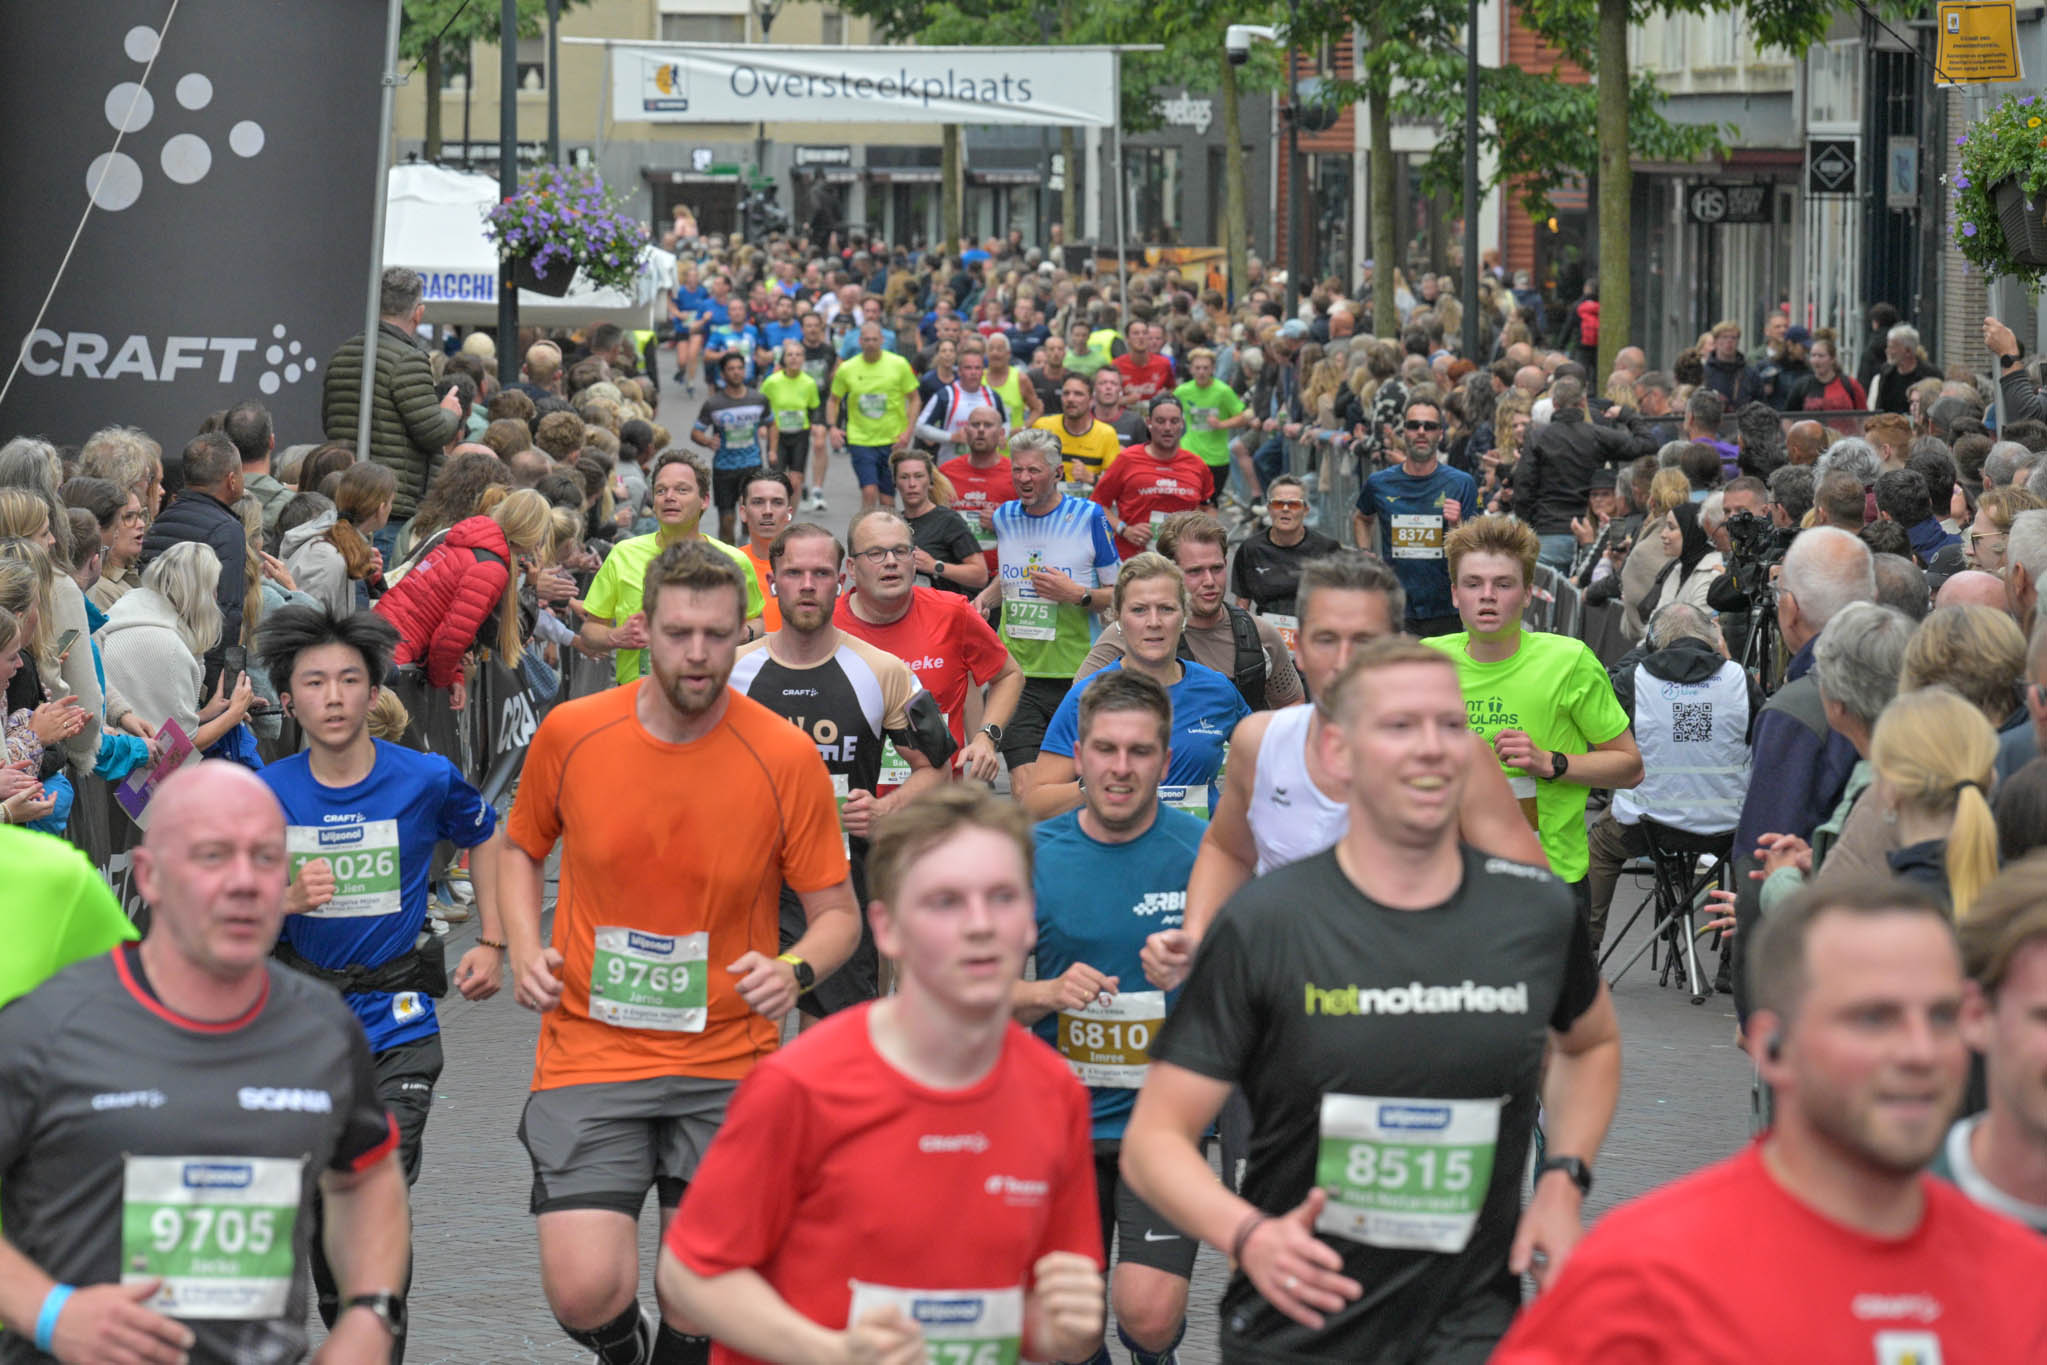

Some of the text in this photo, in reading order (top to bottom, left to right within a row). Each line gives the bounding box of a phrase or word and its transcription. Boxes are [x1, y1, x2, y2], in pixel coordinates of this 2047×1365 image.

[730, 64, 1032, 106] Oversteekplaats
[20, 328, 257, 383] CRAFT
[1399, 529, 1434, 541] 8374
[1010, 603, 1048, 619] 9775
[323, 814, 356, 823] CRAFT
[296, 850, 394, 881] 026
[607, 956, 689, 993] 9769
[1069, 1020, 1149, 1050] 6810
[1089, 1051, 1125, 1063] Imree
[237, 1086, 332, 1113] SCANIA
[1345, 1143, 1473, 1191] 8515
[150, 1206, 276, 1255] 9705
